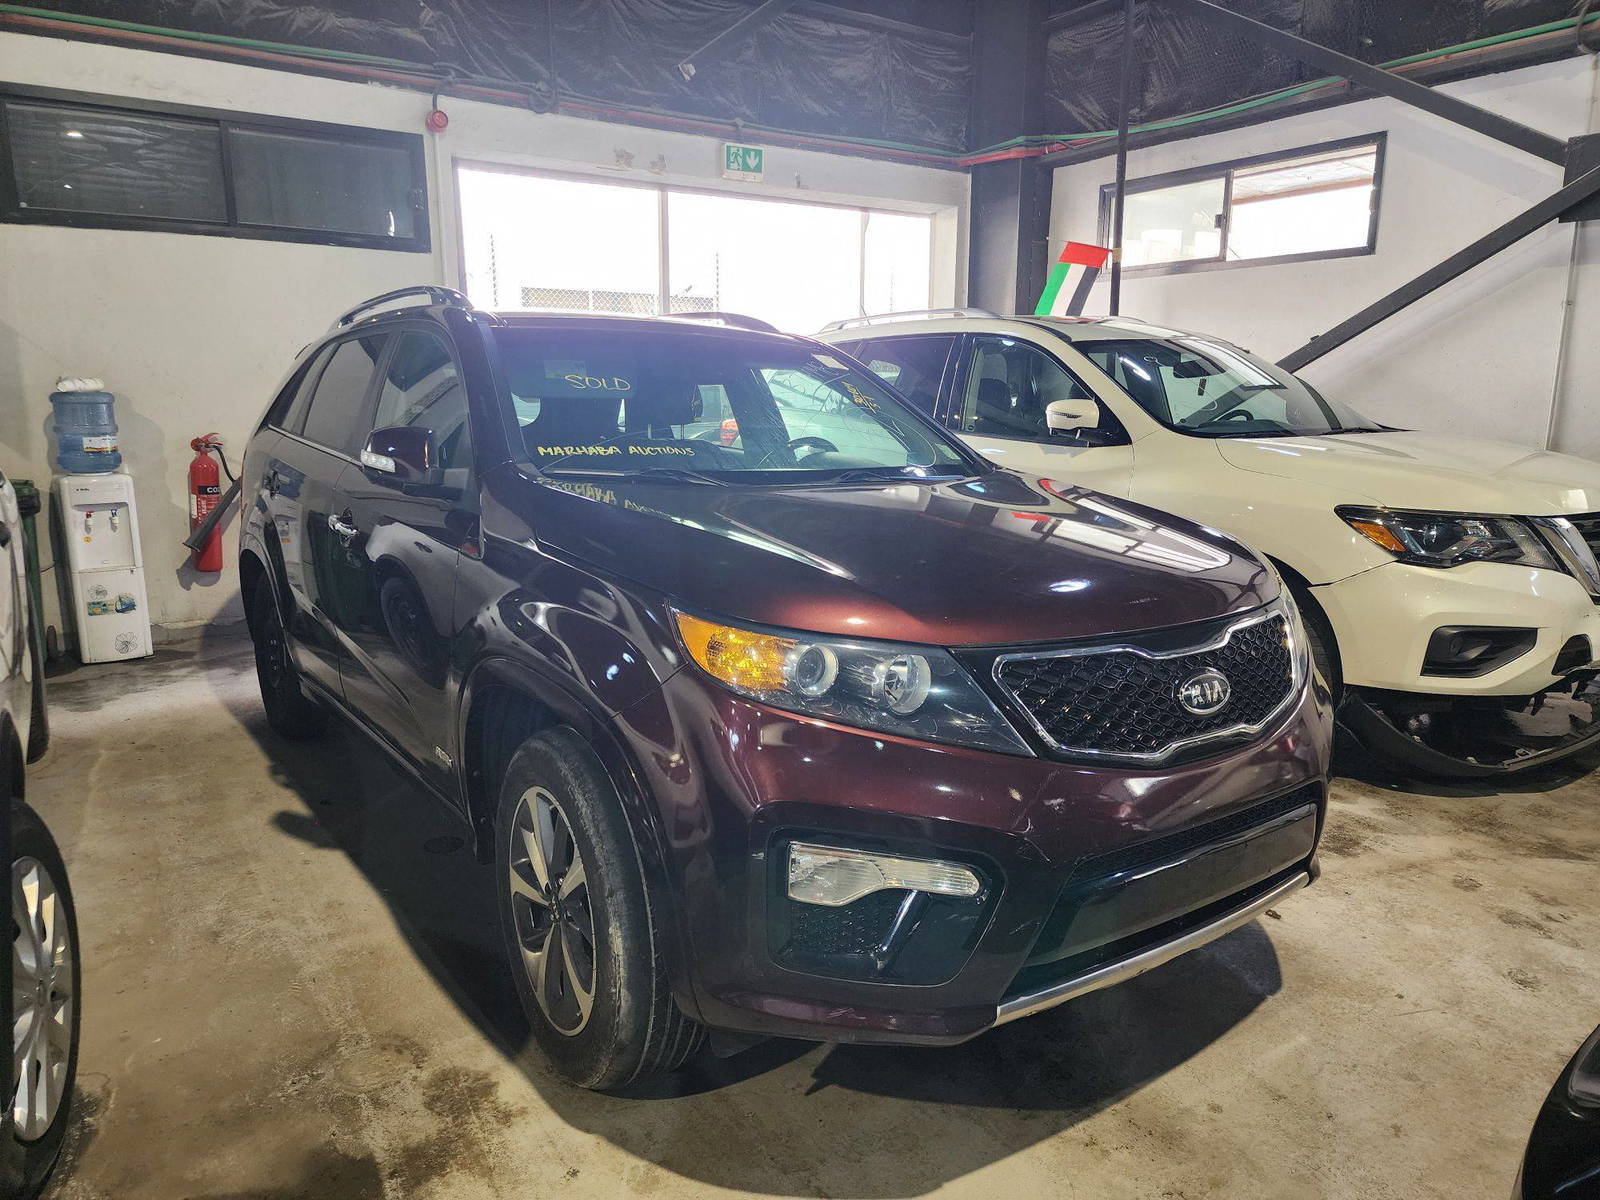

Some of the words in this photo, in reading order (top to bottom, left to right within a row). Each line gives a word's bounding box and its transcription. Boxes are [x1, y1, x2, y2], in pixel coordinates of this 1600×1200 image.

[564, 374, 631, 391] SOLD
[537, 446, 622, 456] MARHABA
[629, 445, 696, 457] AUCTIONS
[1188, 680, 1225, 706] KIA
